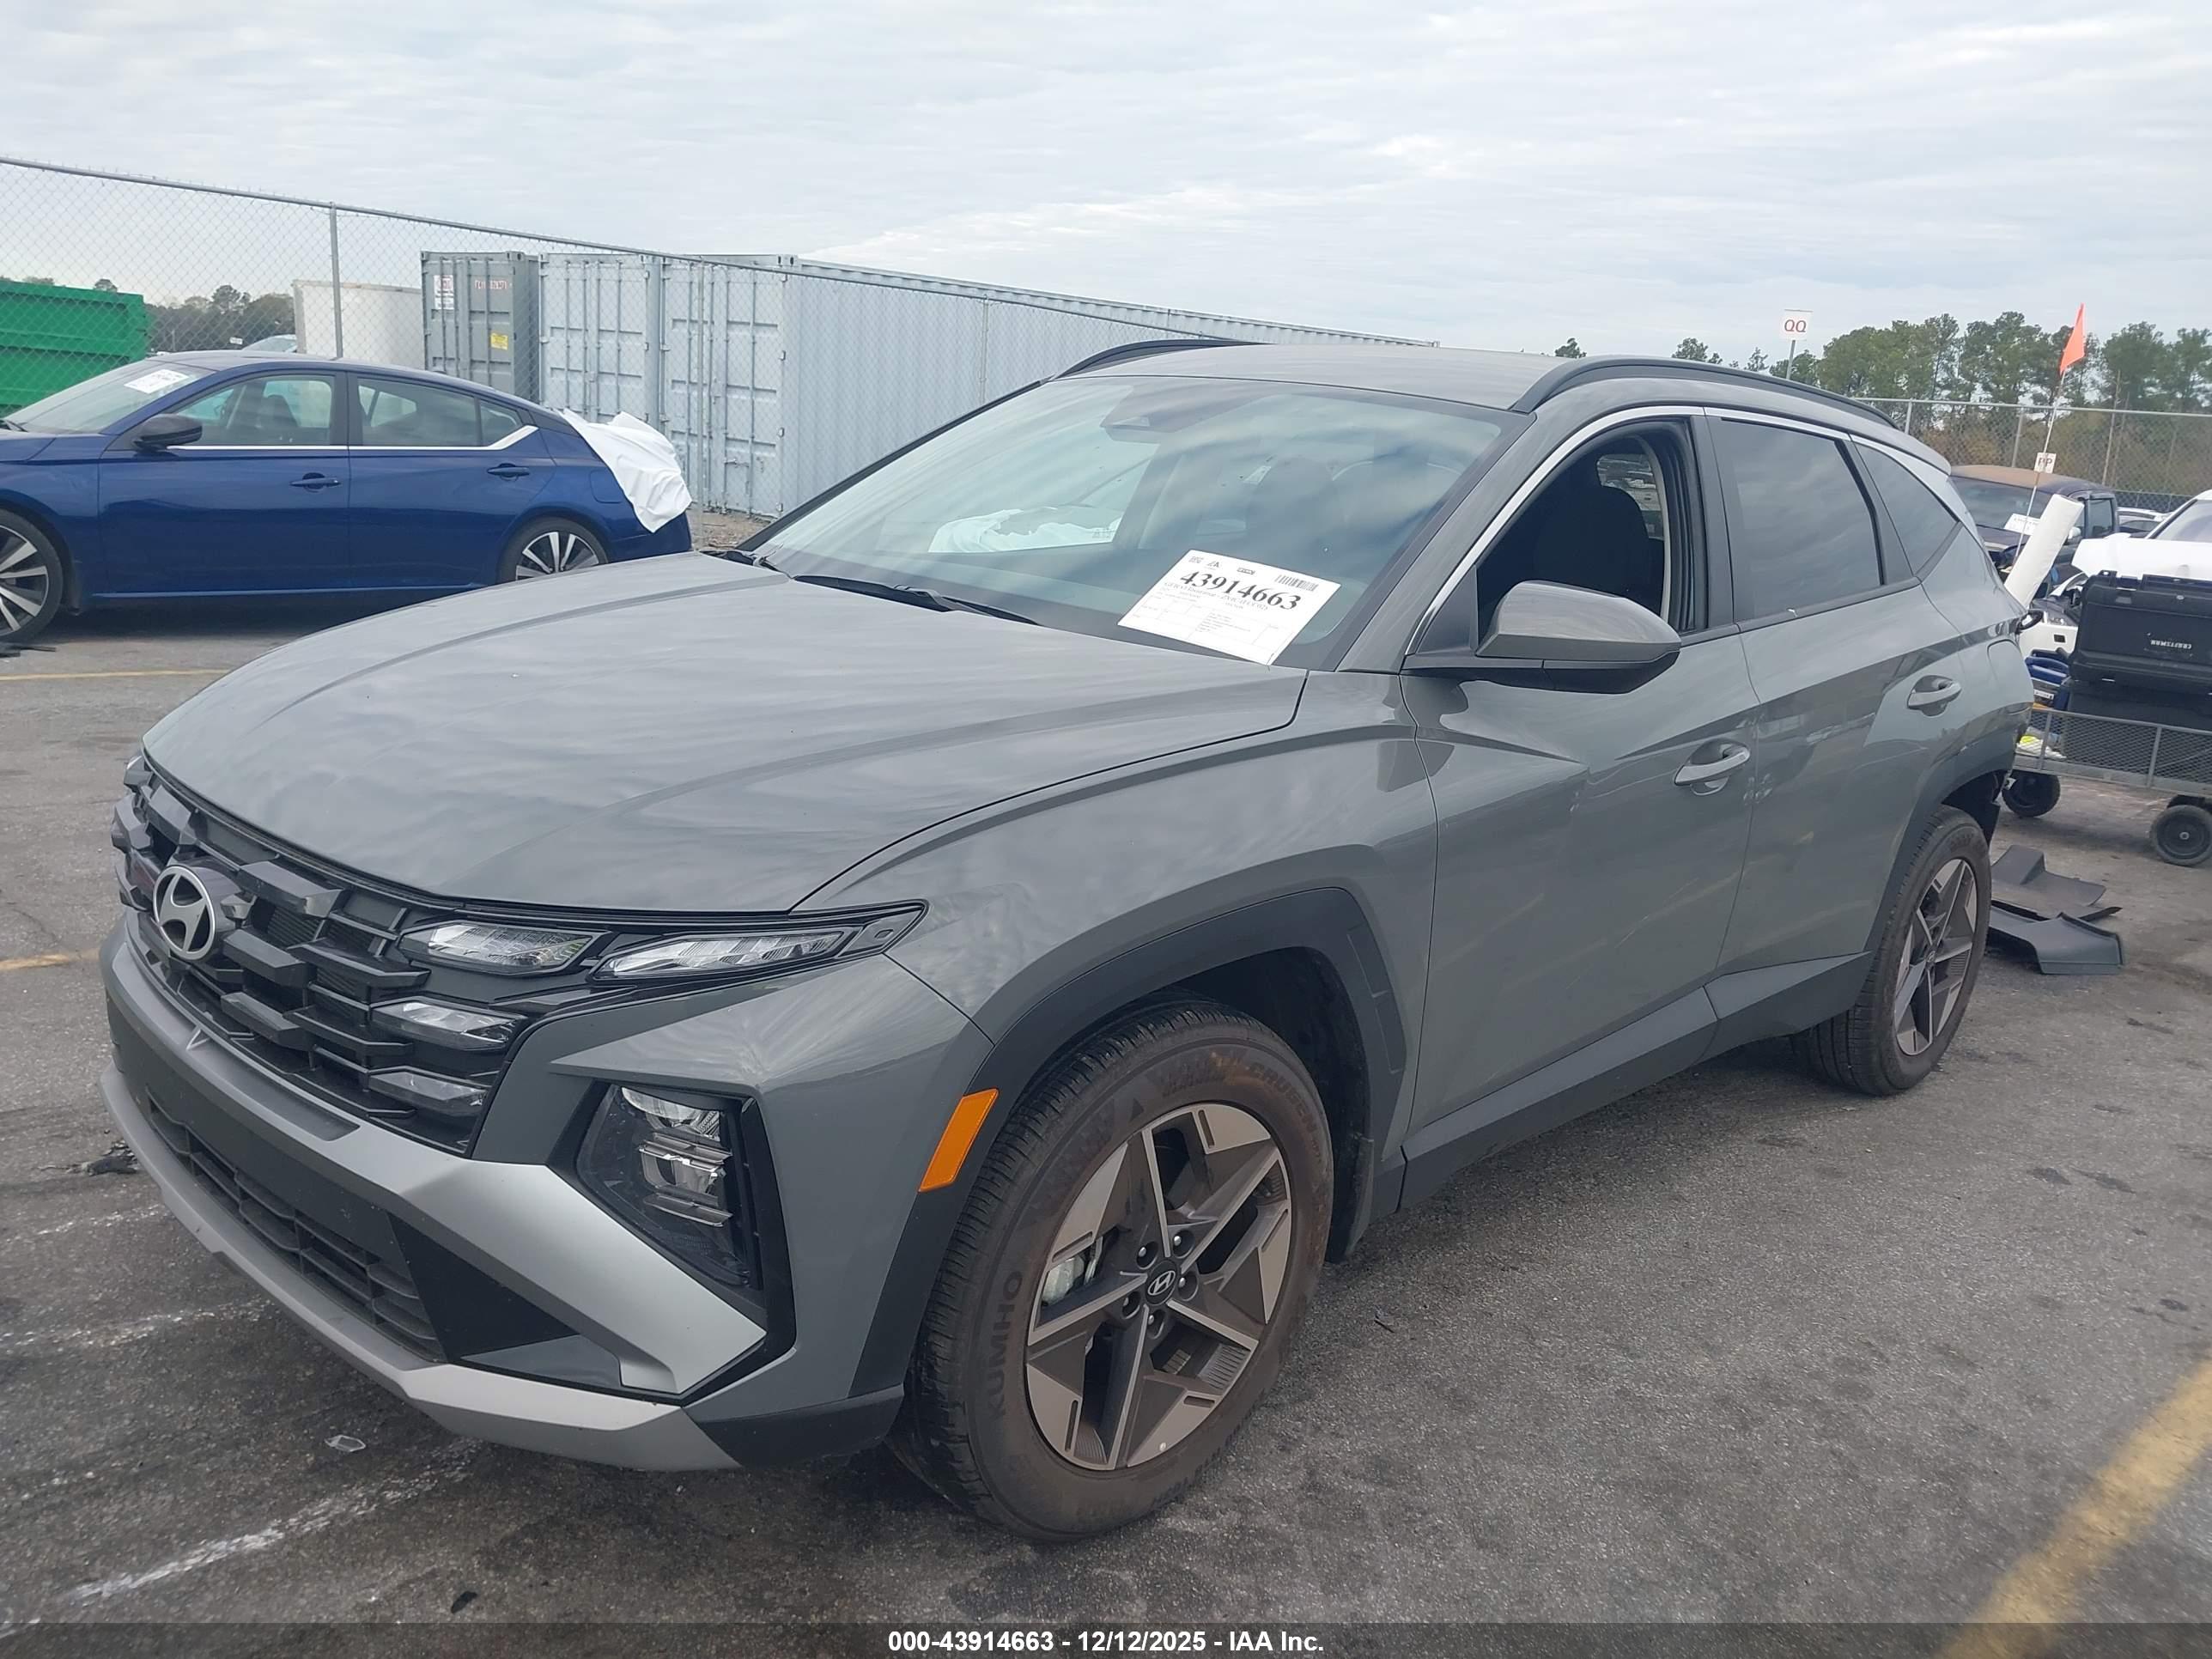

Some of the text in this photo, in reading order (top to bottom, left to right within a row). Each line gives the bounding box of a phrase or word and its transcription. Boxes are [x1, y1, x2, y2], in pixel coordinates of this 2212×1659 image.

[1784, 319, 1807, 333] QQ
[1180, 570, 1302, 611] 43914663
[2150, 639, 2192, 649] CRAFTSMAN
[988, 1270, 1024, 1419] KUMHO
